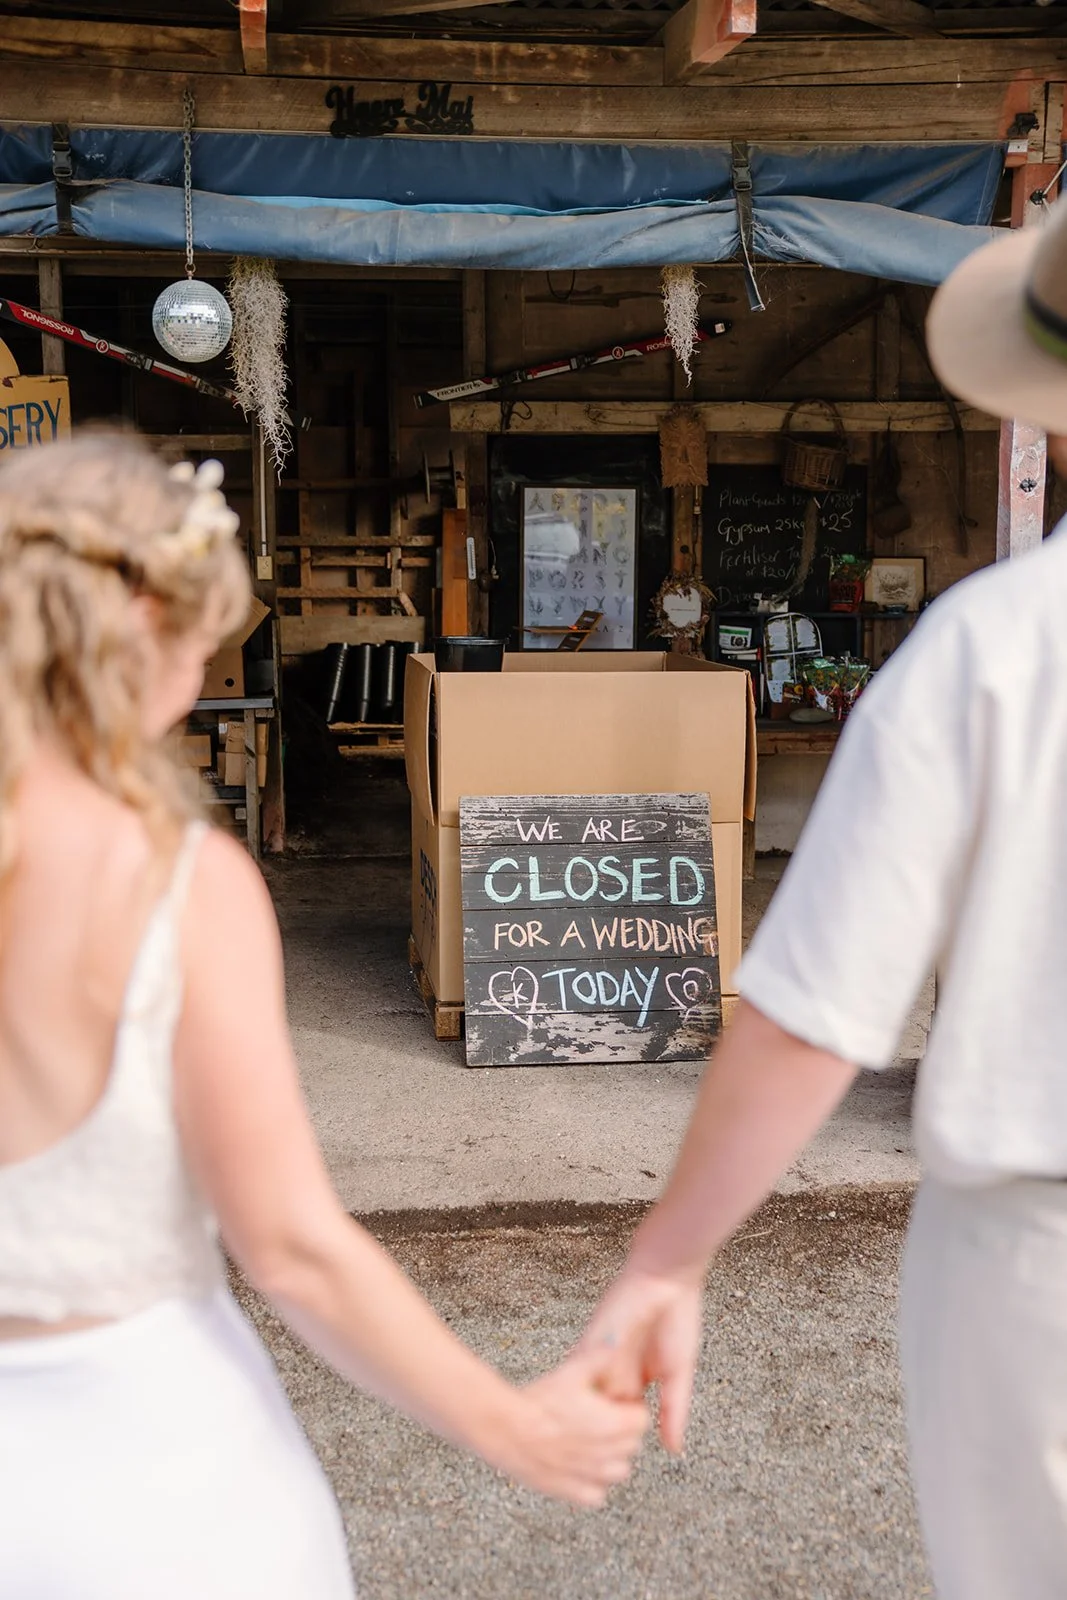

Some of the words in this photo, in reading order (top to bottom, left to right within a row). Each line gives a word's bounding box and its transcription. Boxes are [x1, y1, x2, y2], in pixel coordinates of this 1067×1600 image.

[19, 308, 75, 336] ROSSIGNOL
[717, 517, 771, 546] Gypsum
[719, 545, 780, 571] Fertiliser
[516, 816, 563, 842] WE
[581, 817, 645, 843] ARE
[484, 856, 706, 905] CLOSED
[494, 920, 550, 951] FOR
[560, 920, 586, 949] A
[591, 916, 717, 957] WEDDING
[541, 966, 660, 1028] TODAY
